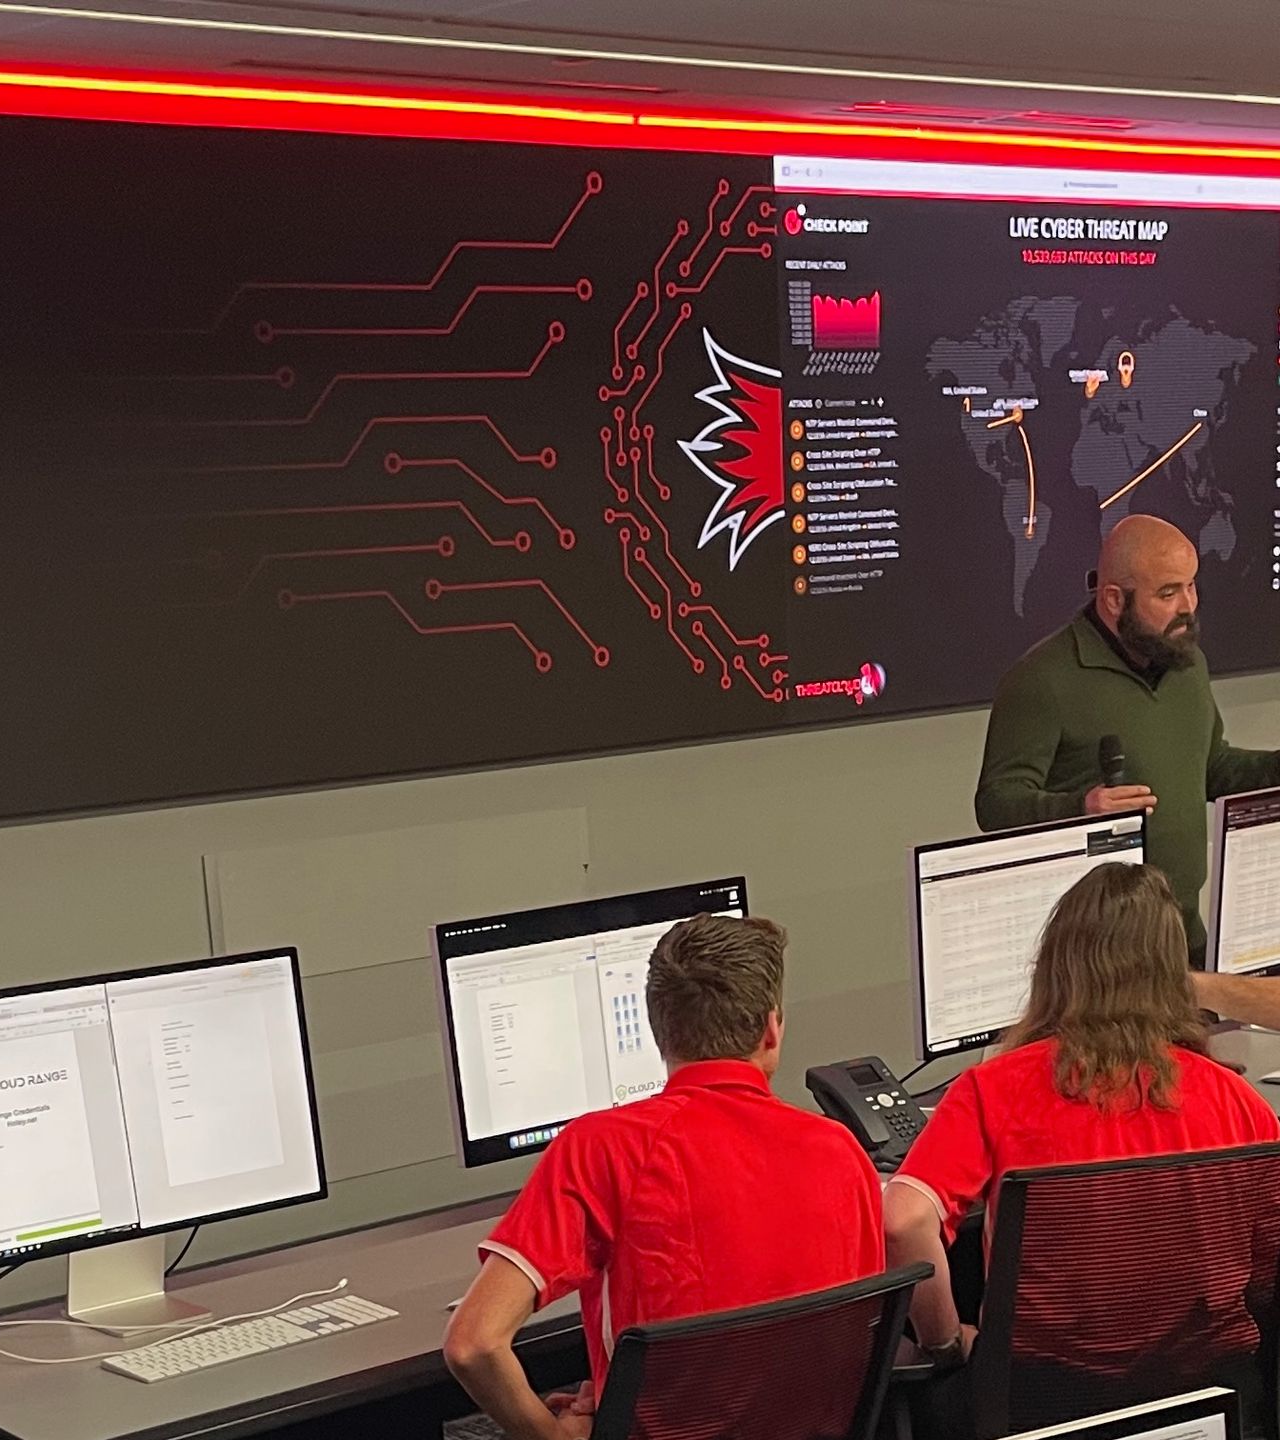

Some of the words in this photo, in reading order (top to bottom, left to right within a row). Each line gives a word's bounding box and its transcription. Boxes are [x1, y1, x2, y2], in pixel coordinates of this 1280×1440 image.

[803, 218, 837, 232] CHECK
[838, 219, 870, 233] POINT
[1009, 217, 1039, 238] LIVE
[1040, 218, 1084, 239] CYBER
[1085, 219, 1136, 240] THREAT
[1138, 221, 1168, 240] MAP
[1068, 251, 1103, 264] ATTACKS
[1105, 252, 1119, 264] ON
[1120, 252, 1138, 264] THIS
[1139, 253, 1156, 265] DAY
[26, 1069, 68, 1085] RANGE
[626, 1080, 656, 1094] CLOUD
